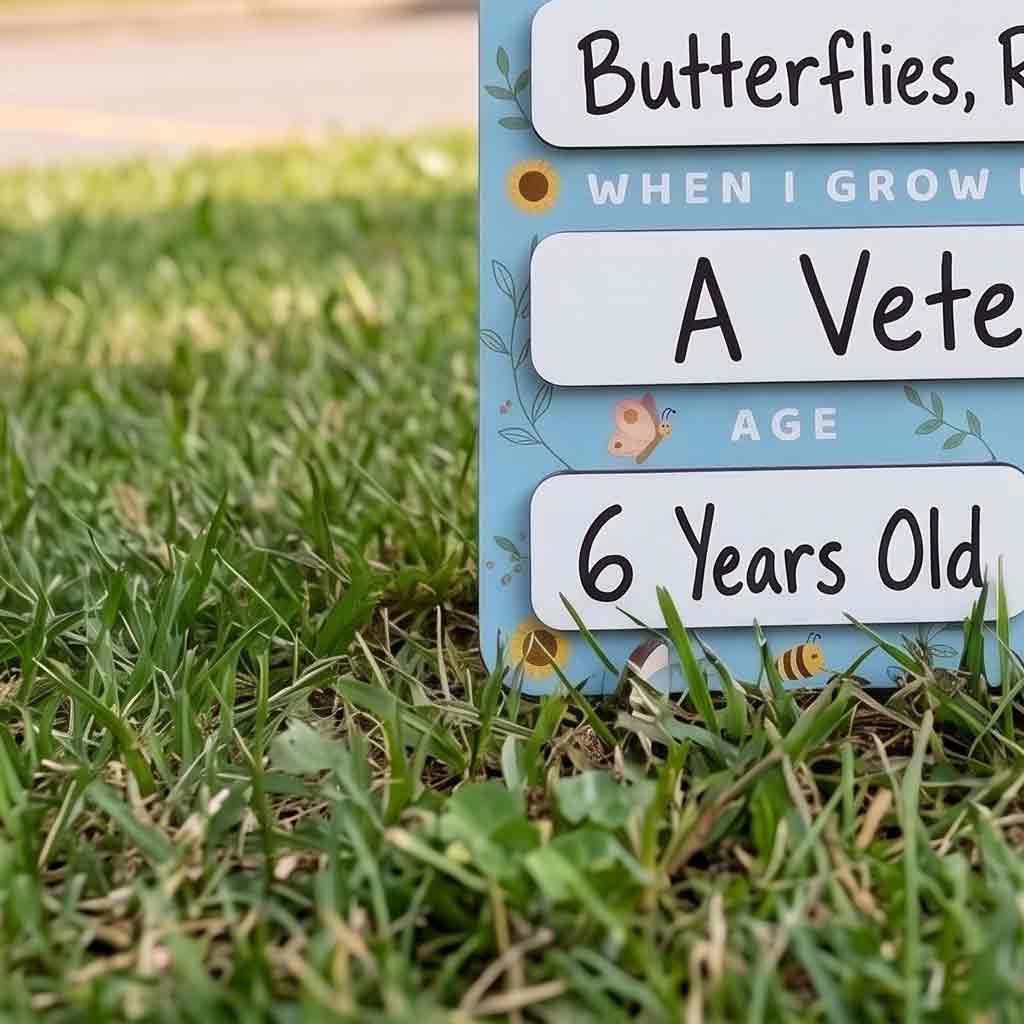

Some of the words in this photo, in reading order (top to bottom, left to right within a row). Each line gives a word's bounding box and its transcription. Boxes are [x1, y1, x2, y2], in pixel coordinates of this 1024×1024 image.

[577, 29, 975, 116] Butterflies,
[587, 172, 751, 205] WHEN
[784, 172, 794, 202] I
[826, 168, 990, 202] GROW
[674, 256, 743, 364] A
[731, 407, 836, 441] AGE
[578, 503, 634, 603] 6
[674, 502, 846, 601] Years
[878, 504, 983, 592] Old
